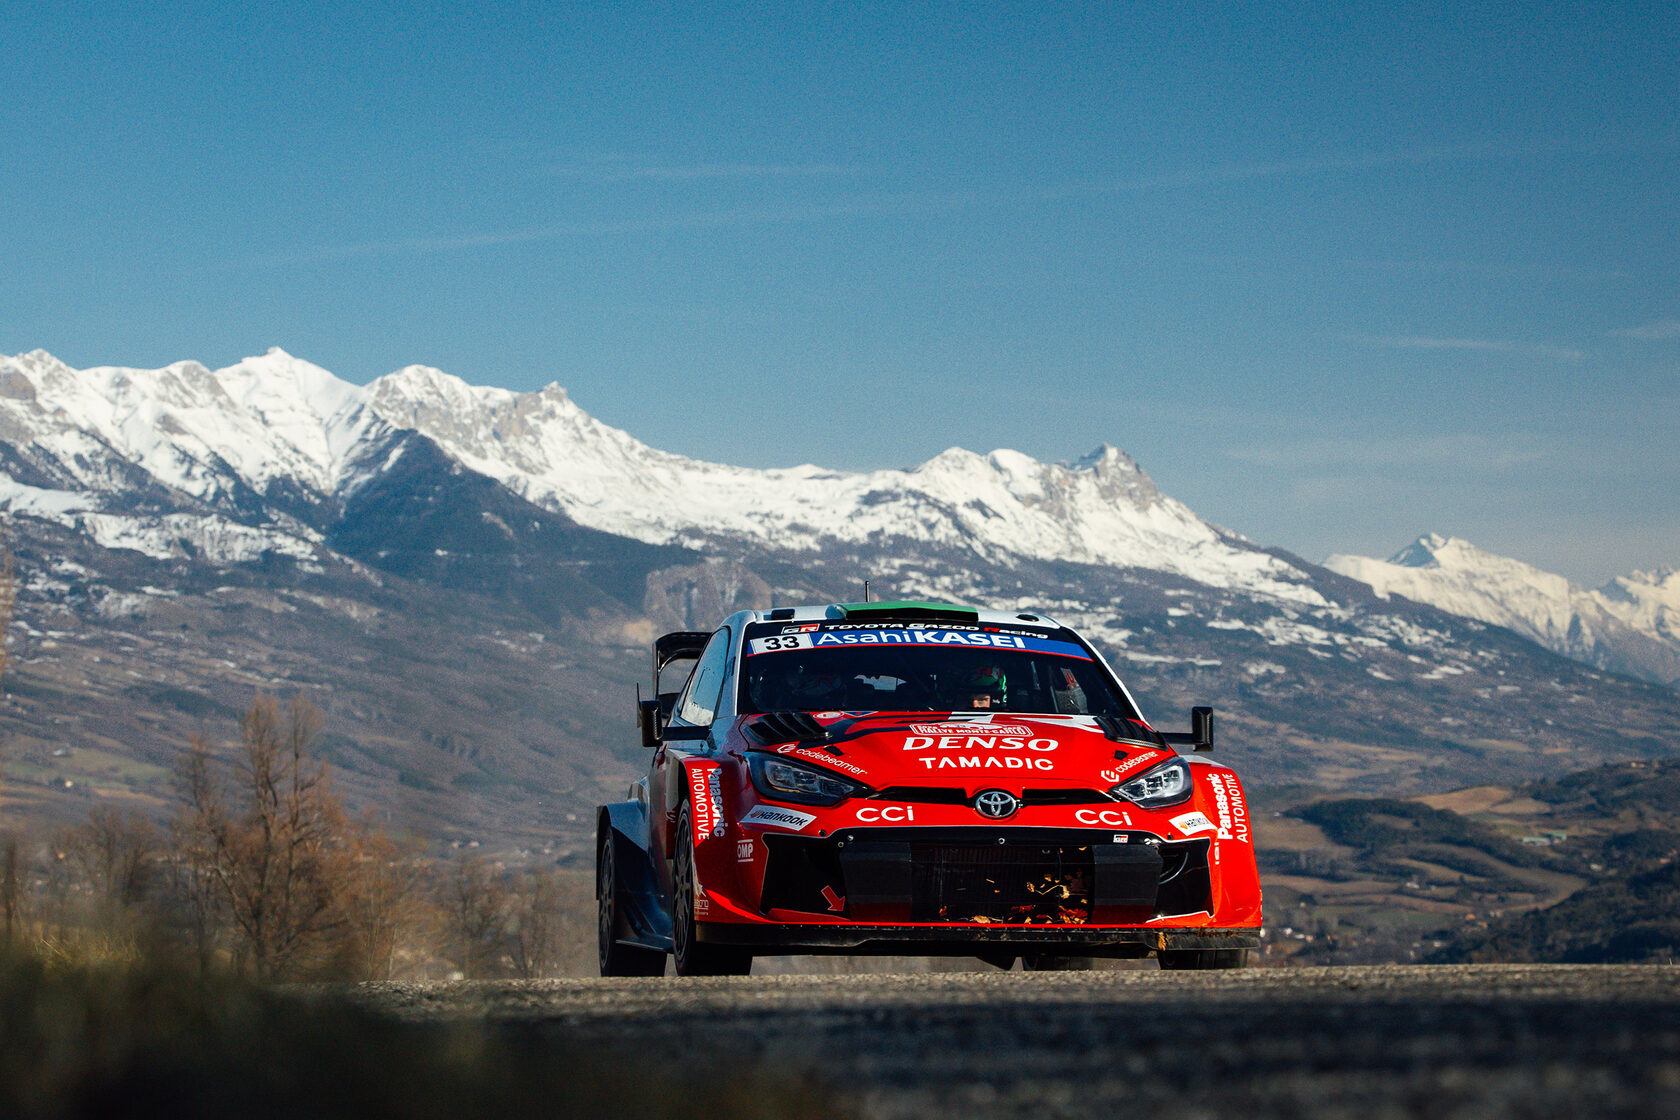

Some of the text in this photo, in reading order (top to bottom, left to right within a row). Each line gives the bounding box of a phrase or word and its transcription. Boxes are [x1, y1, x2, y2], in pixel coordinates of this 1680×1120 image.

[906, 623, 979, 631] GAZOO
[984, 626, 1048, 639] Racing
[764, 636, 800, 650] 33
[903, 736, 1059, 752] DENSO
[796, 748, 867, 776] codebeamer
[919, 756, 1054, 771] TAMADIC
[691, 768, 710, 841] AUTOMOTIVE
[707, 768, 728, 837] Panasonic
[1206, 773, 1234, 840] Panasonic
[1221, 773, 1249, 844] AUTOMOTIVE
[737, 843, 754, 859] OMP
